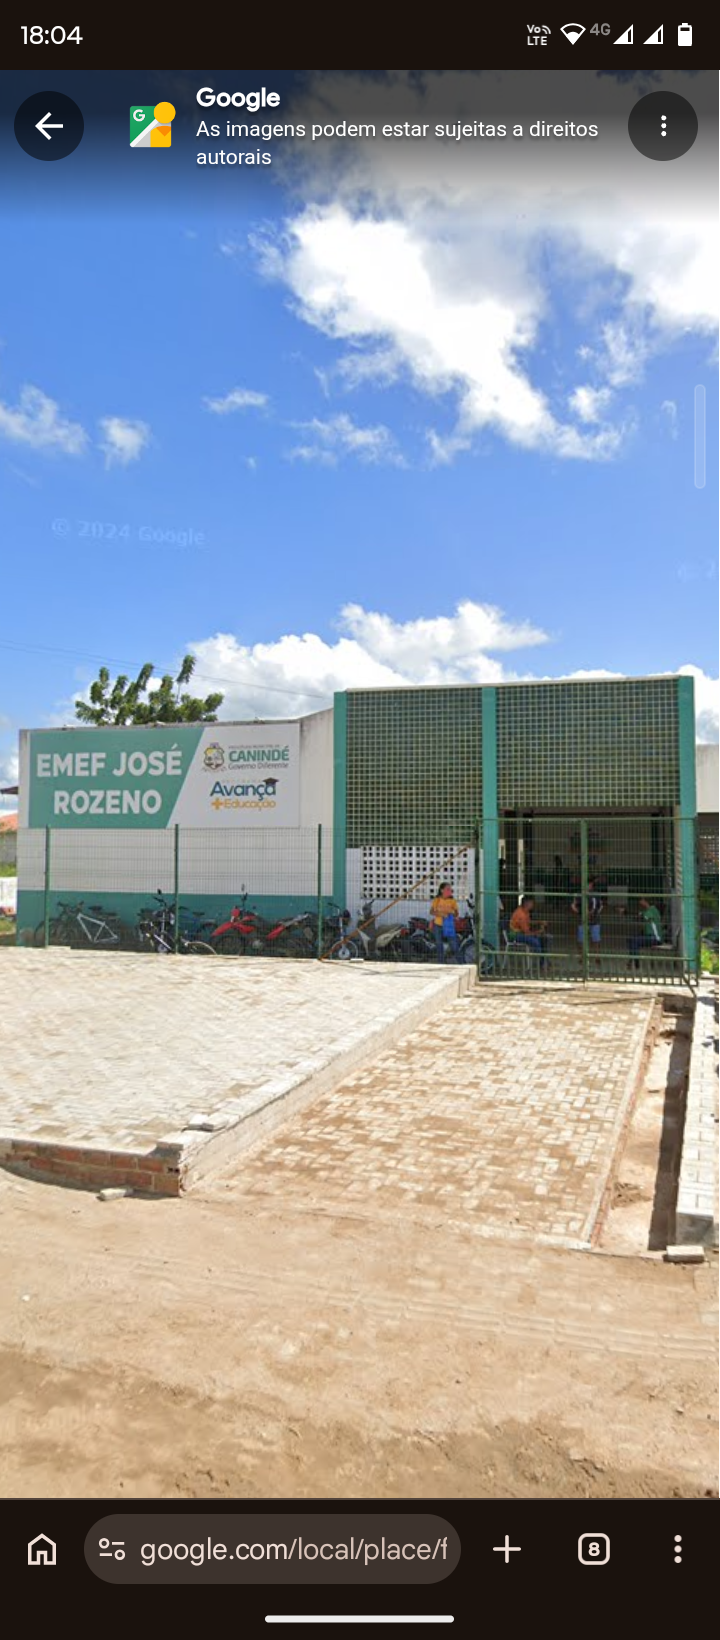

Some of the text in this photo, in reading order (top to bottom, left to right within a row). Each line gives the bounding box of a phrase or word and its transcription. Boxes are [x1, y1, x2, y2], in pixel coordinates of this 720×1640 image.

[36, 743, 183, 777] EMEF JOSÉ
[229, 746, 290, 762] CANINDÉ
[53, 789, 163, 815] ROZENO
[210, 781, 276, 801] Avança
